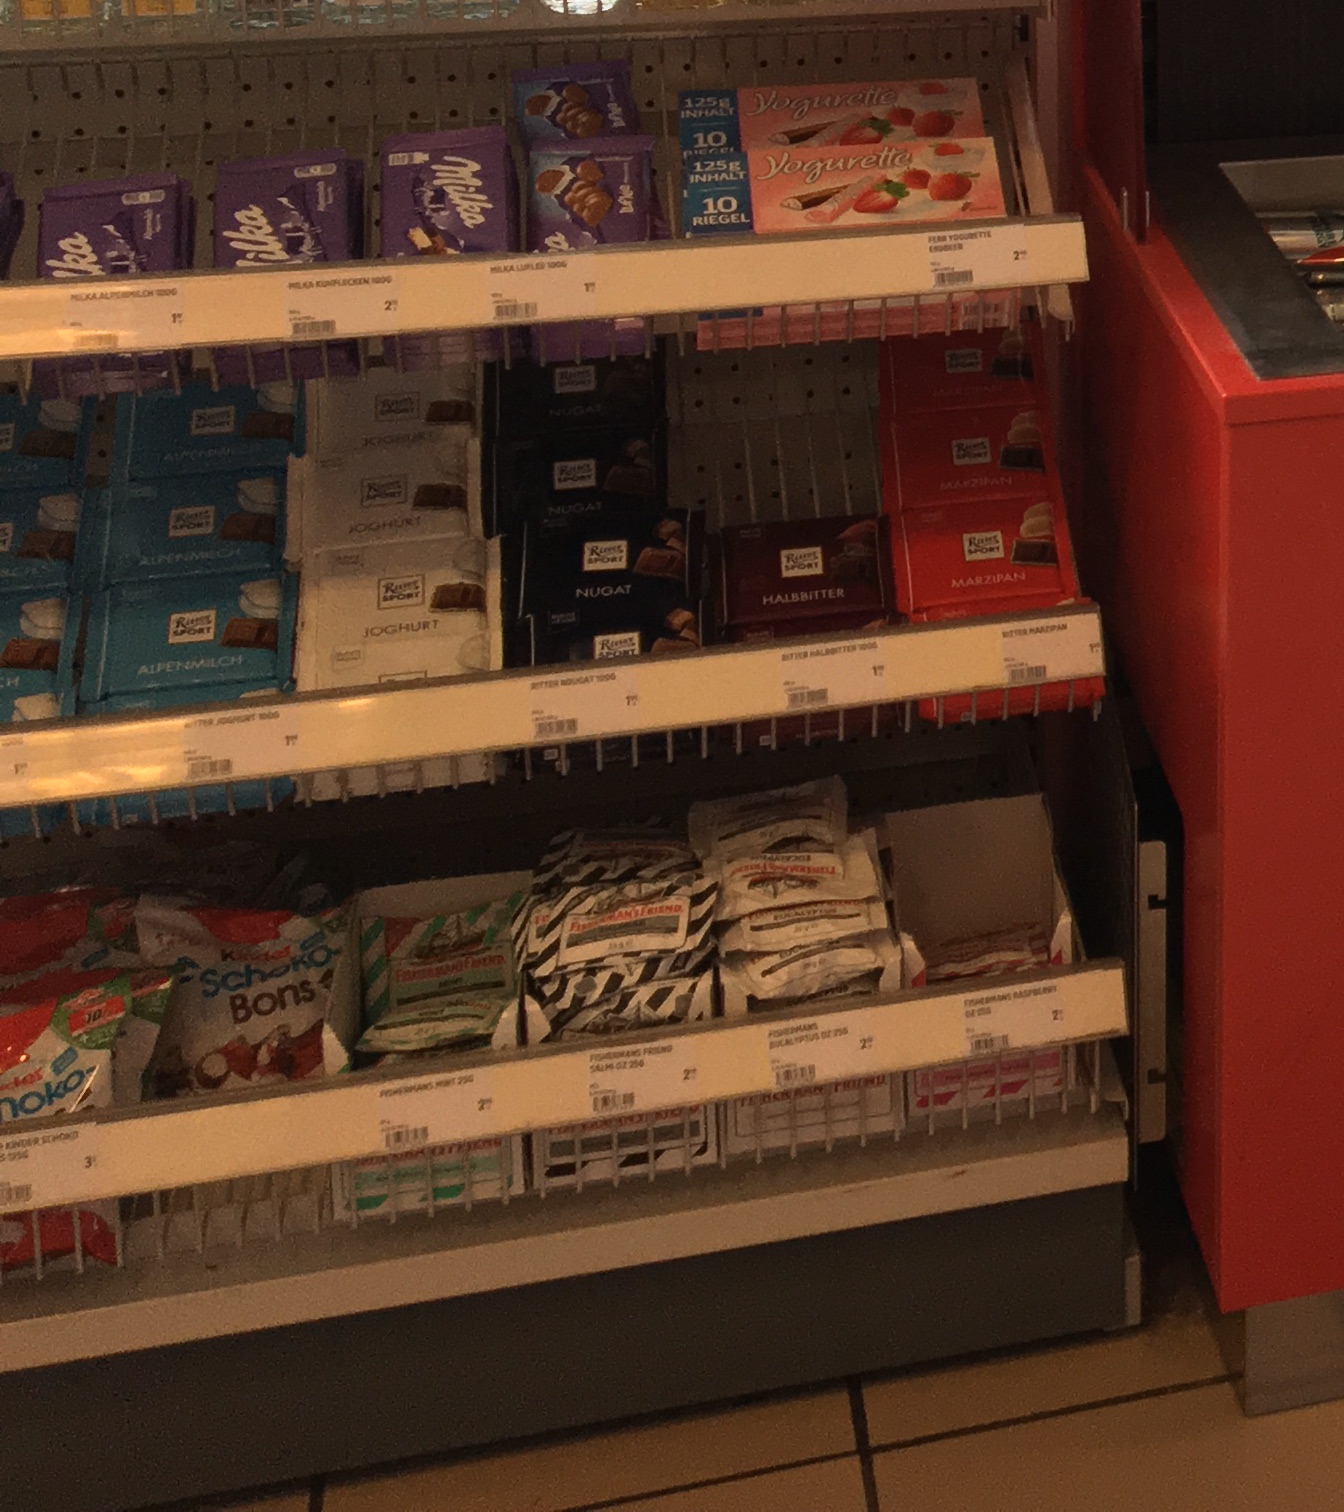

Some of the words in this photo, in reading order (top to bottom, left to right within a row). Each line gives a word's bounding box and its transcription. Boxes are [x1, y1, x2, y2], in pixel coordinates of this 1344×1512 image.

[747, 88, 899, 118] Yogurette
[680, 105, 735, 119] INHALT
[694, 130, 727, 148] 10
[693, 158, 742, 174] 125g
[757, 148, 913, 183] Yogurette
[689, 169, 747, 184] INHALT
[702, 196, 737, 214] 10
[692, 211, 751, 226] RIEGEL
[587, 555, 626, 568] SPORT
[951, 571, 1026, 588] MARZIPAN
[382, 592, 422, 605] SPORT
[576, 583, 632, 598] NUGAT
[762, 587, 846, 605] HALBBITTER
[173, 625, 214, 638] SPORT
[364, 618, 440, 639] JOGHURT
[139, 655, 242, 676] ALPENMILCH
[200, 943, 341, 997] Schoko-
[229, 979, 315, 1025] Bons
